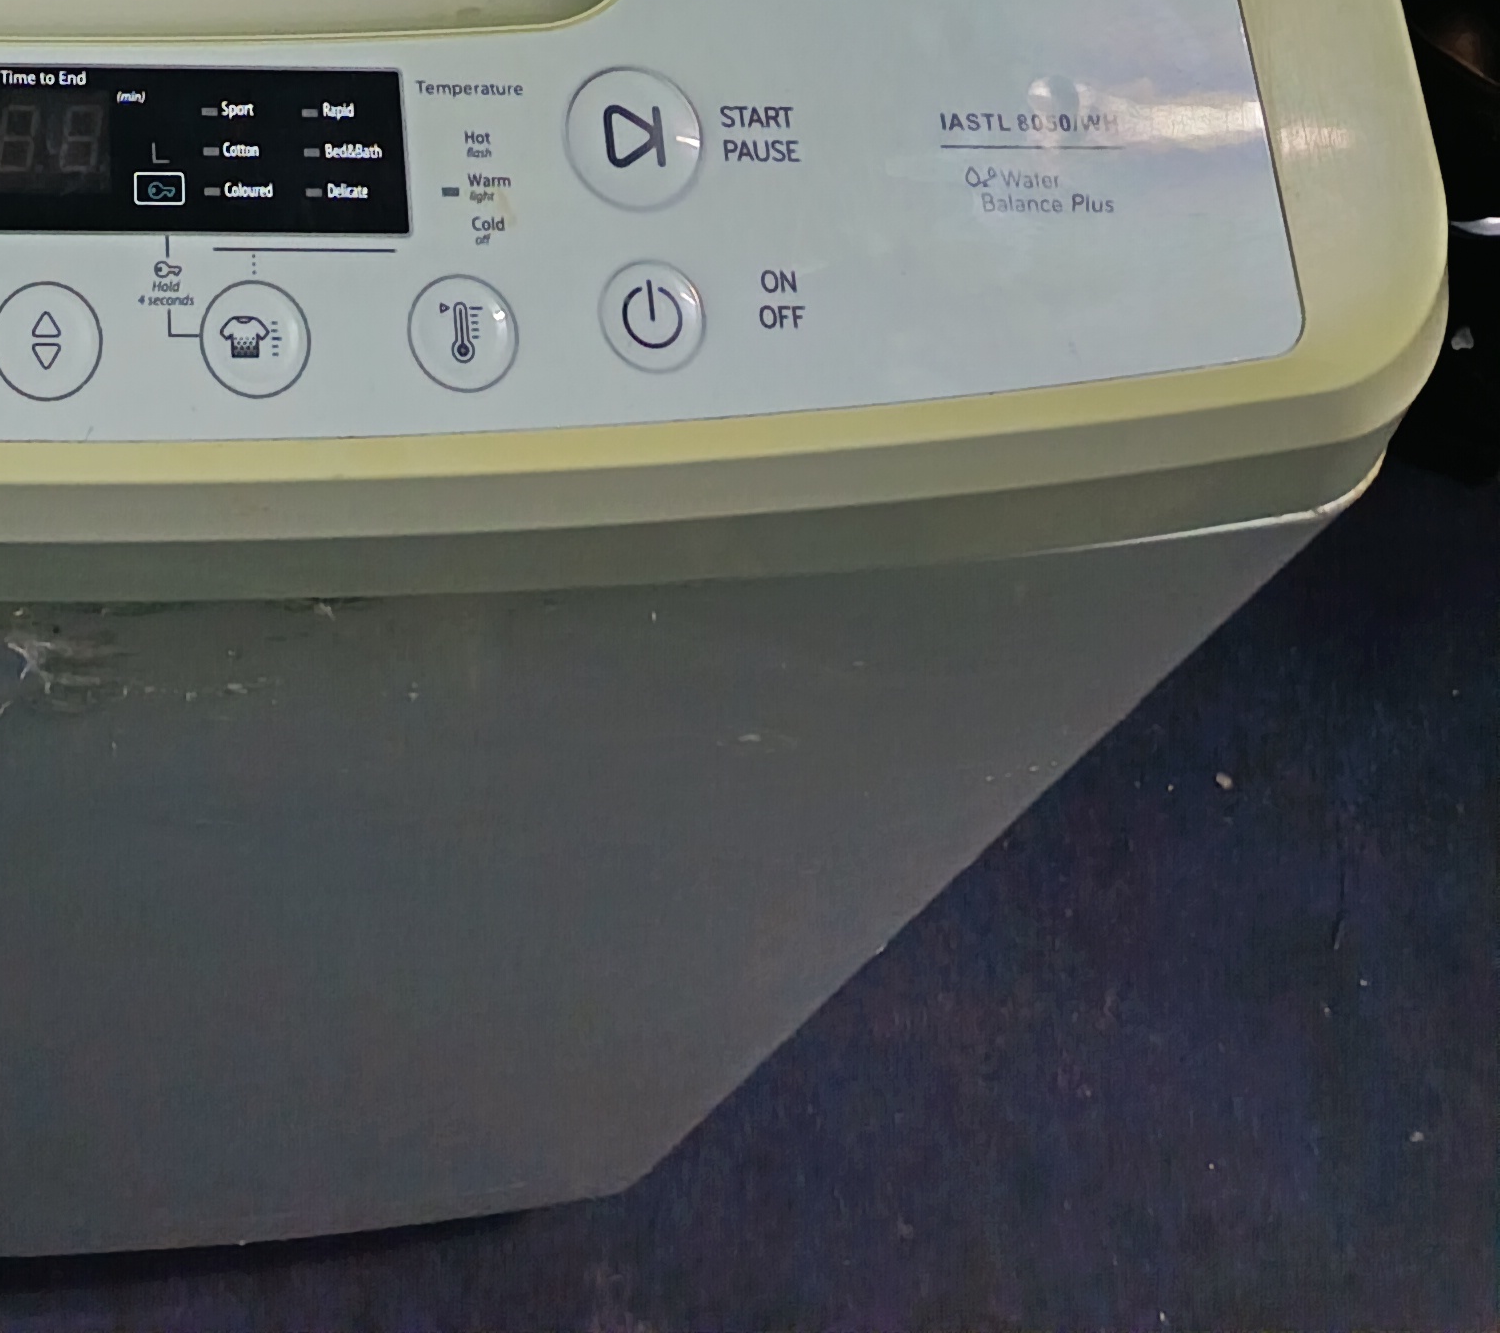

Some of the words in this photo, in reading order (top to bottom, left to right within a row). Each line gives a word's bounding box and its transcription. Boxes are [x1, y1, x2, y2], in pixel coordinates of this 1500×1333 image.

[0, 70, 36, 85] Time
[40, 72, 55, 85] to
[59, 71, 87, 85] End
[417, 80, 524, 97] Temperature
[221, 101, 254, 118] Sport
[322, 103, 355, 120] Rapid
[720, 106, 794, 129] START
[940, 113, 1011, 132] IASTL
[464, 130, 491, 145] Hot
[222, 142, 259, 157] Cotton
[325, 144, 383, 159] Bed&Bath
[724, 140, 801, 163] PAUSE
[467, 173, 511, 188] Warm
[1003, 170, 1060, 188] Water
[224, 182, 274, 198] Coloured
[327, 183, 368, 199] Delicate
[982, 193, 1063, 213] Balance
[1071, 193, 1115, 213] Plus
[472, 216, 505, 232] Cold
[152, 280, 181, 293] Hold
[760, 270, 798, 293] ON
[148, 295, 195, 306] seconds
[759, 305, 806, 329] OFF
